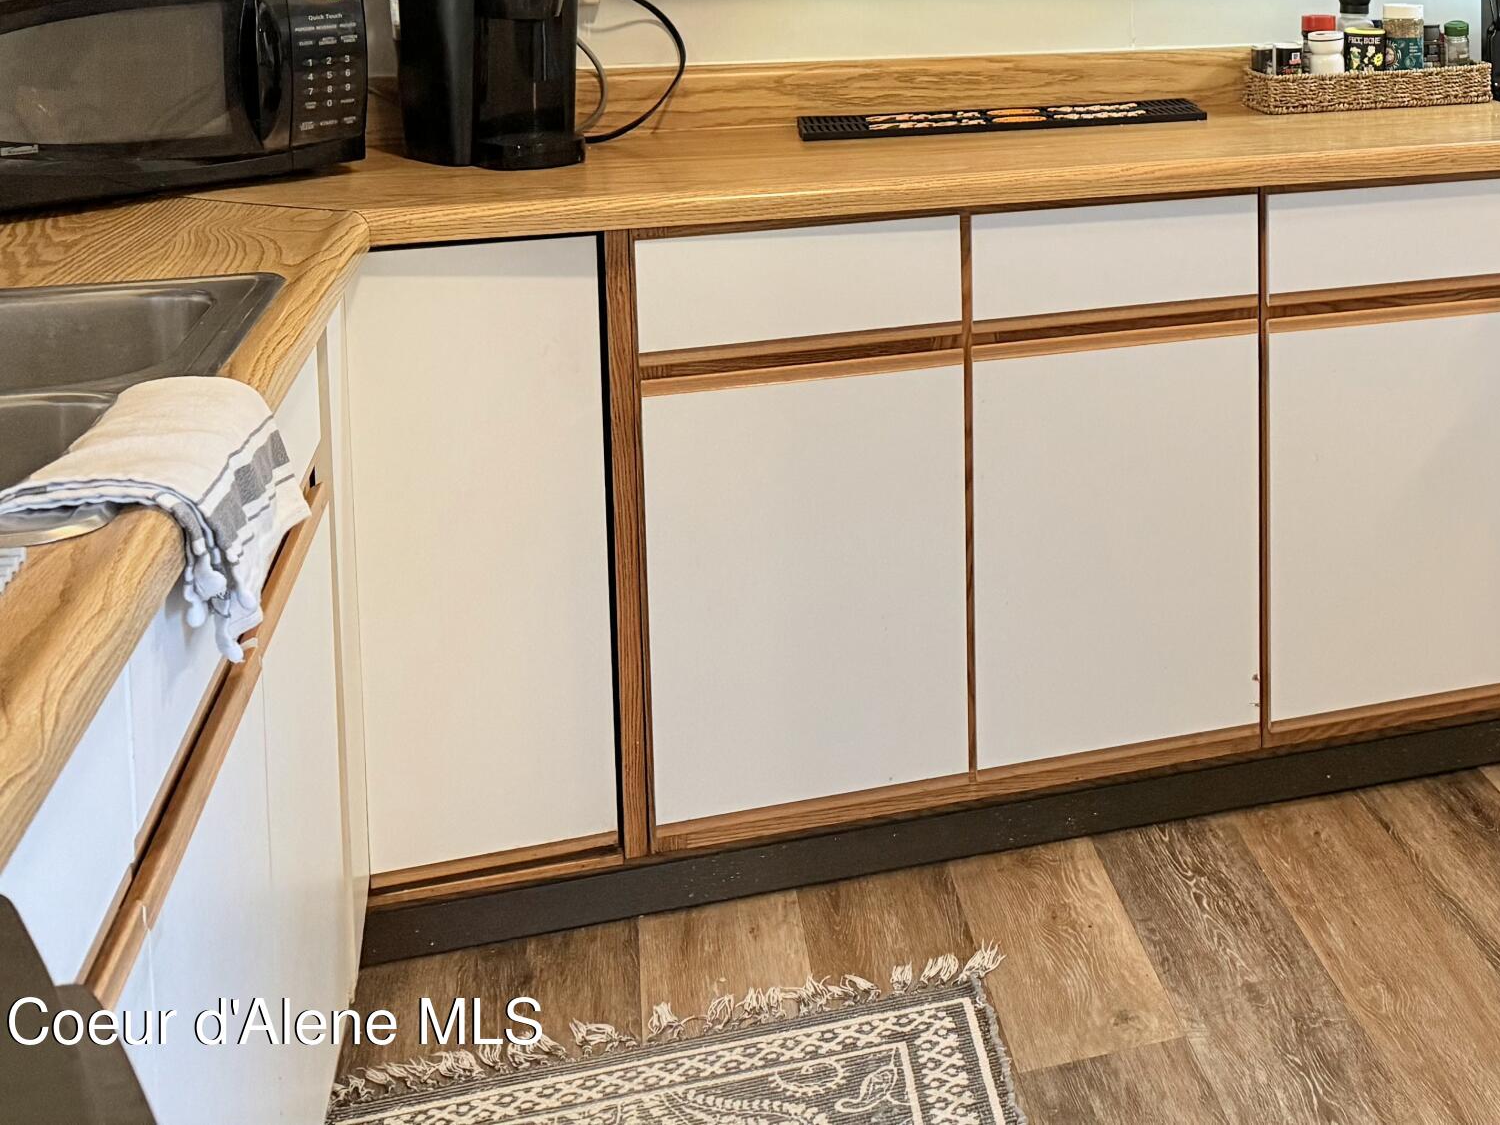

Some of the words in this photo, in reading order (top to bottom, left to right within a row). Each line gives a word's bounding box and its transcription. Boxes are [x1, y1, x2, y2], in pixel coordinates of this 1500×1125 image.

[326, 57, 332, 65] 2
[344, 54, 350, 63] 3
[307, 59, 312, 67] 1
[326, 71, 333, 79] 5
[345, 68, 351, 77] 6
[307, 73, 313, 81] 4
[307, 87, 314, 95] 7
[327, 85, 333, 93] 8
[345, 83, 351, 91] 9
[326, 99, 333, 107] 0
